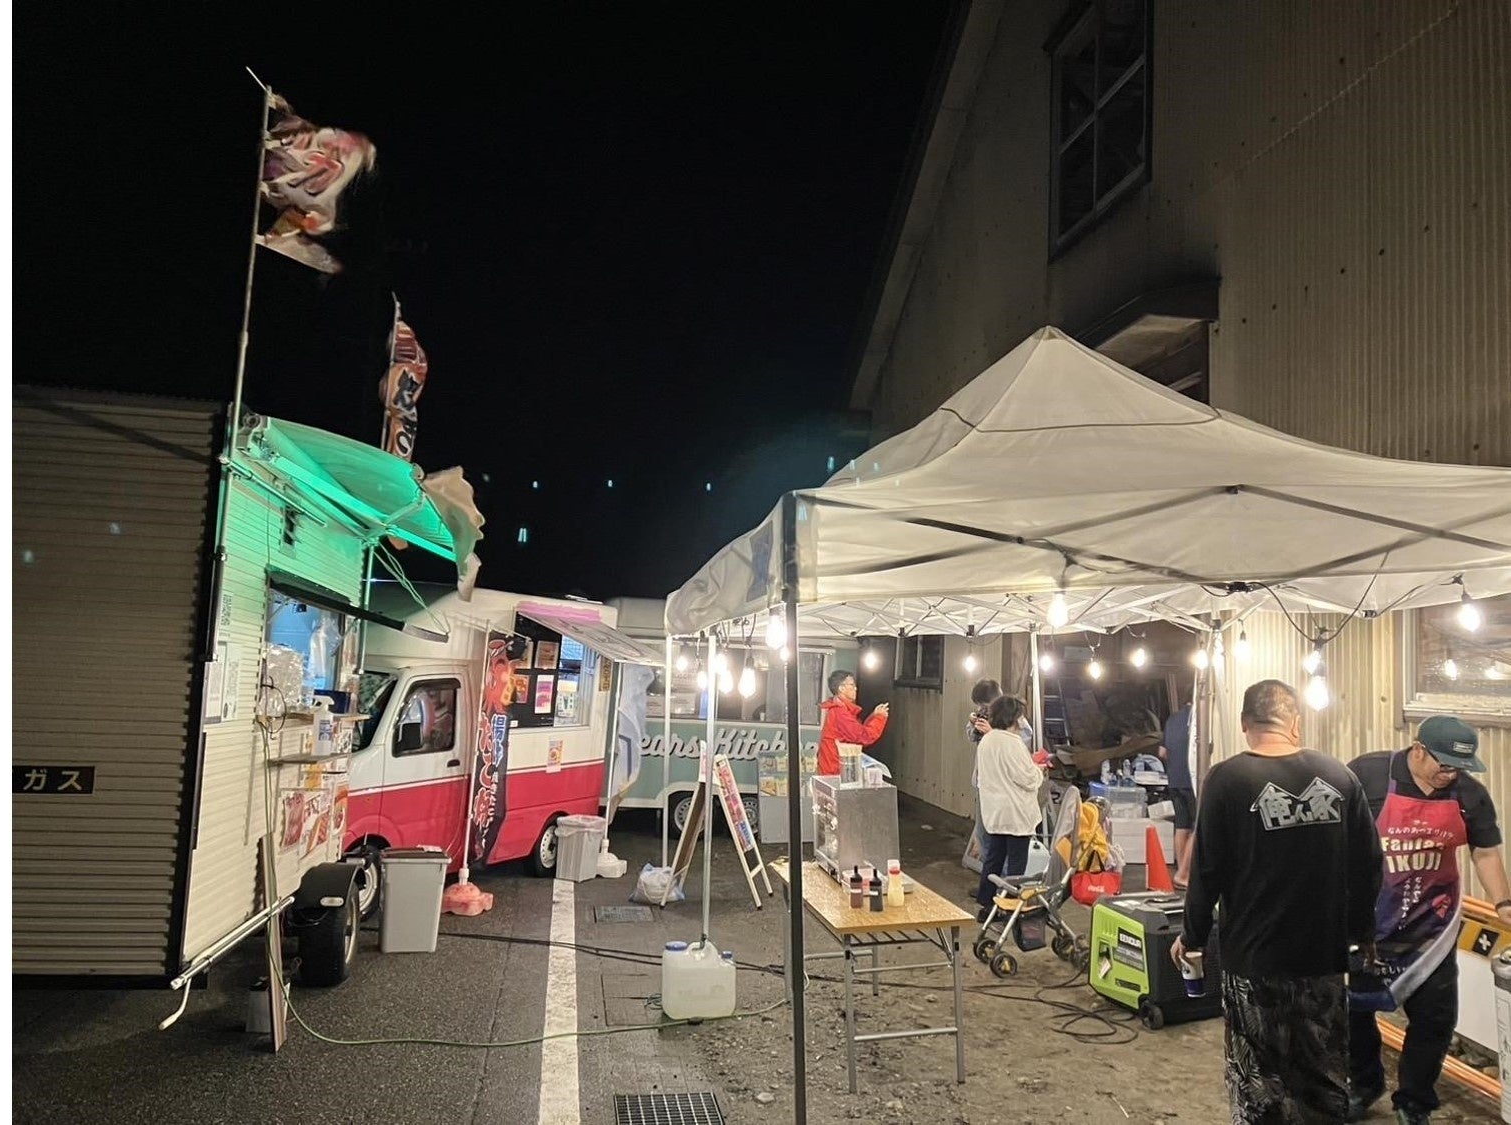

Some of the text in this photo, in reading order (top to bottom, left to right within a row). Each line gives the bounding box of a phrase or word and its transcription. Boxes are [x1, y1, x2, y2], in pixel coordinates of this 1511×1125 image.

[640, 727, 819, 761] ears Kitchn
[22, 768, 83, 791] ガス
[1381, 836, 1445, 852] Fanta
[1386, 852, 1442, 874] IKUJI
